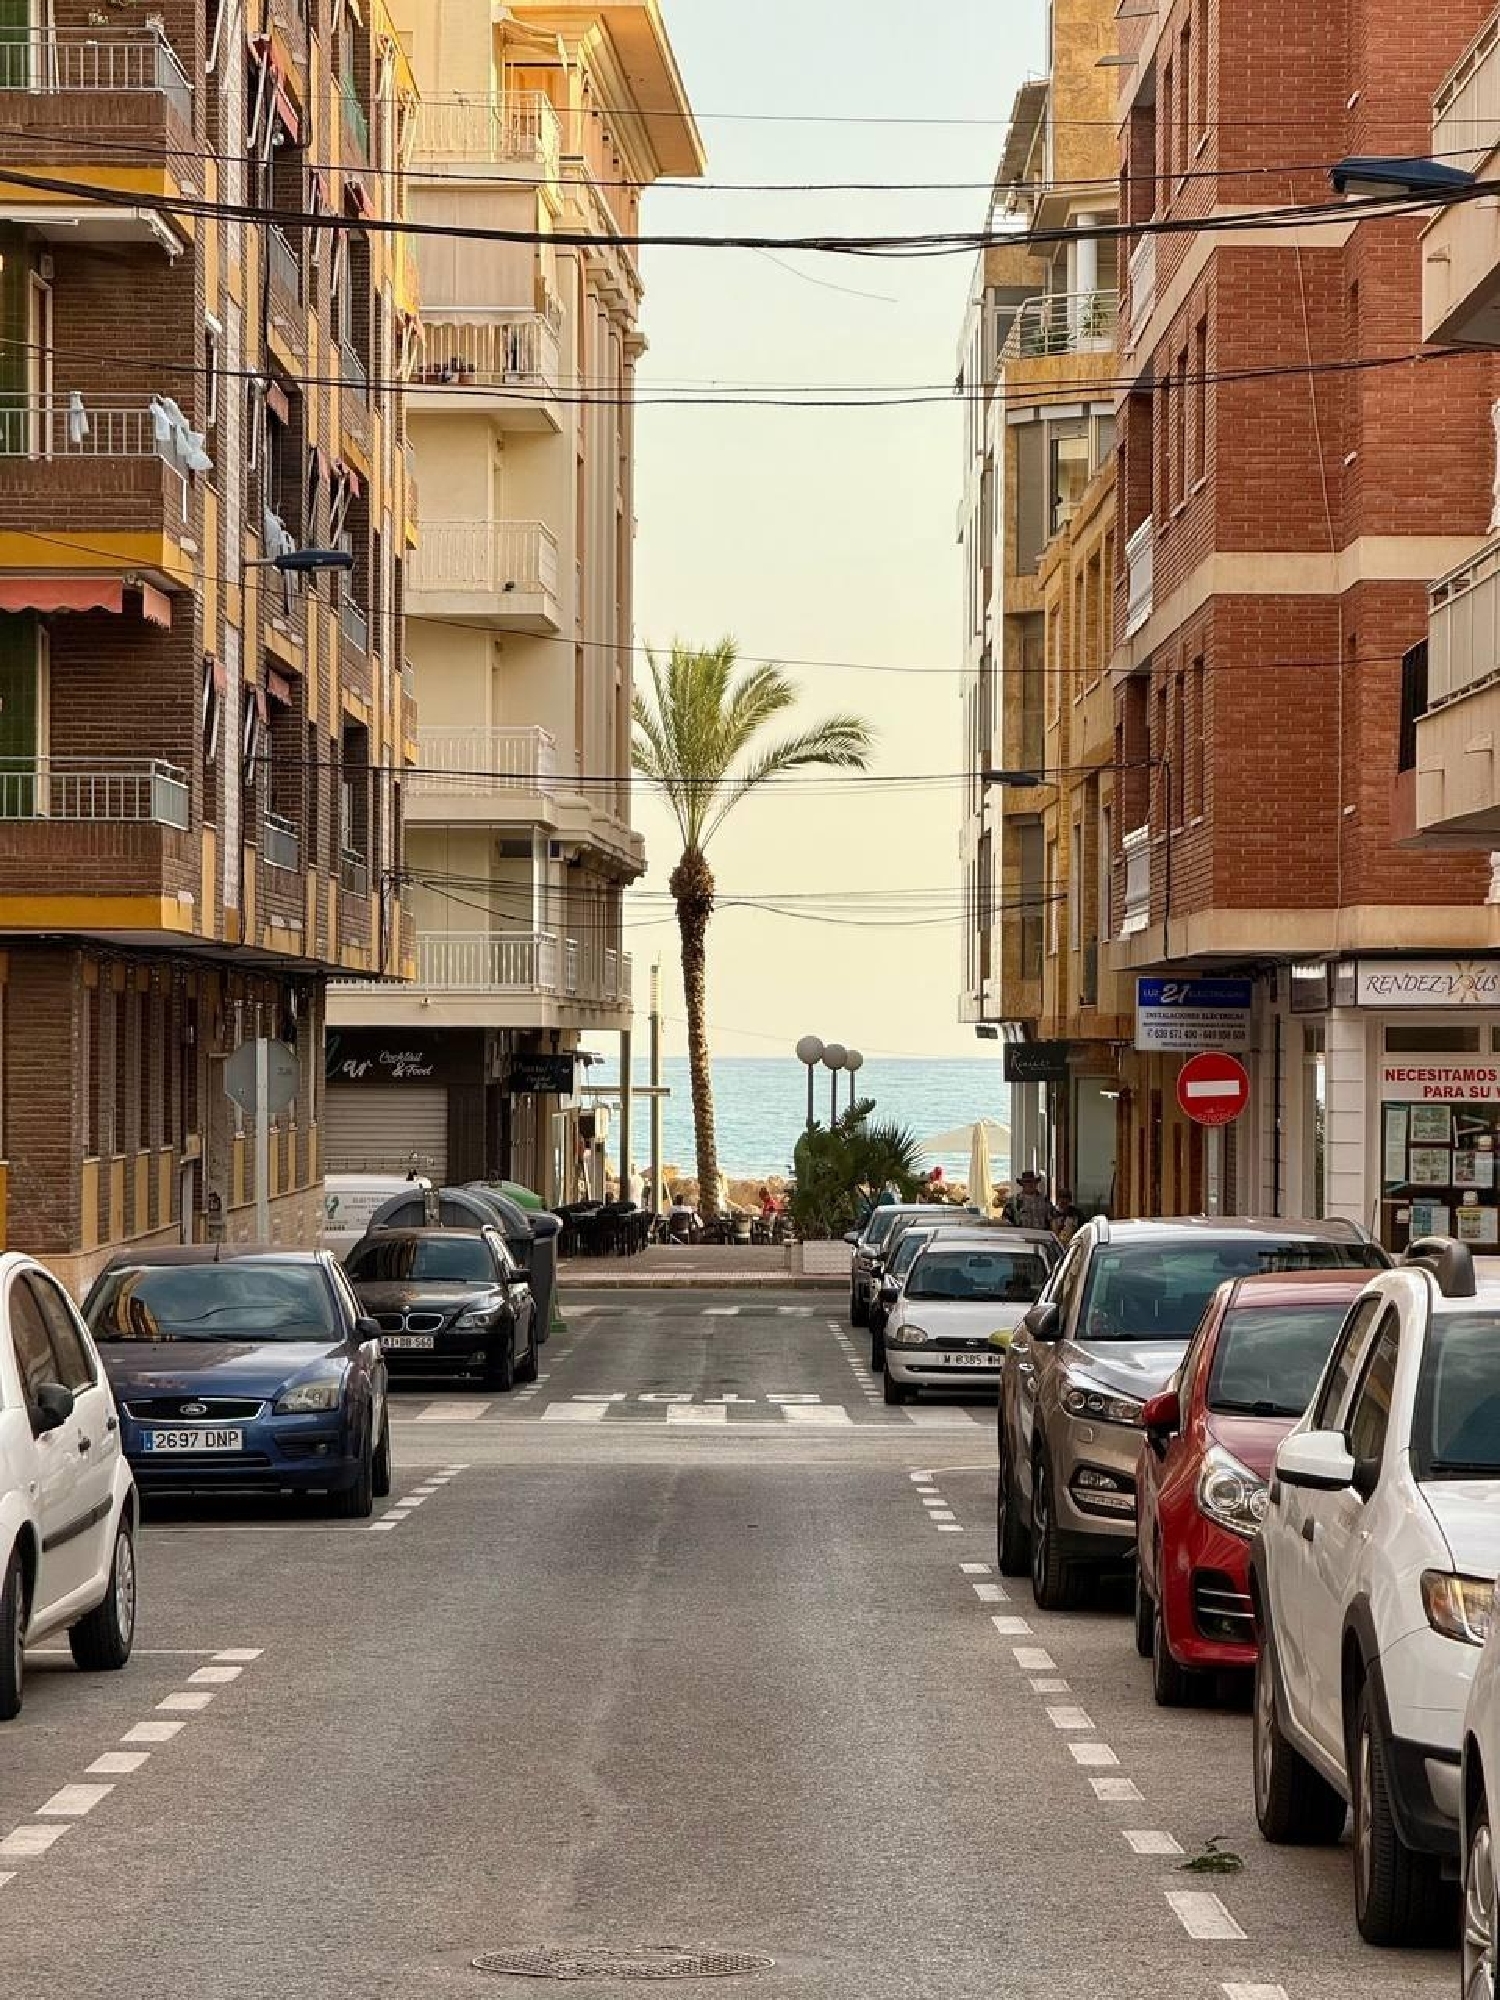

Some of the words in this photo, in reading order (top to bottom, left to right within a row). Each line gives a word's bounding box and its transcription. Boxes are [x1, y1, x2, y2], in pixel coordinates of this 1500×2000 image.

[1160, 983, 1191, 1003] 21
[1385, 1068, 1498, 1082] NECESITAMOS
[1423, 1085, 1465, 1099] PARA
[1469, 1086, 1491, 1099] SU
[155, 1432, 199, 1449] 2697
[205, 1430, 239, 1448] DNP
